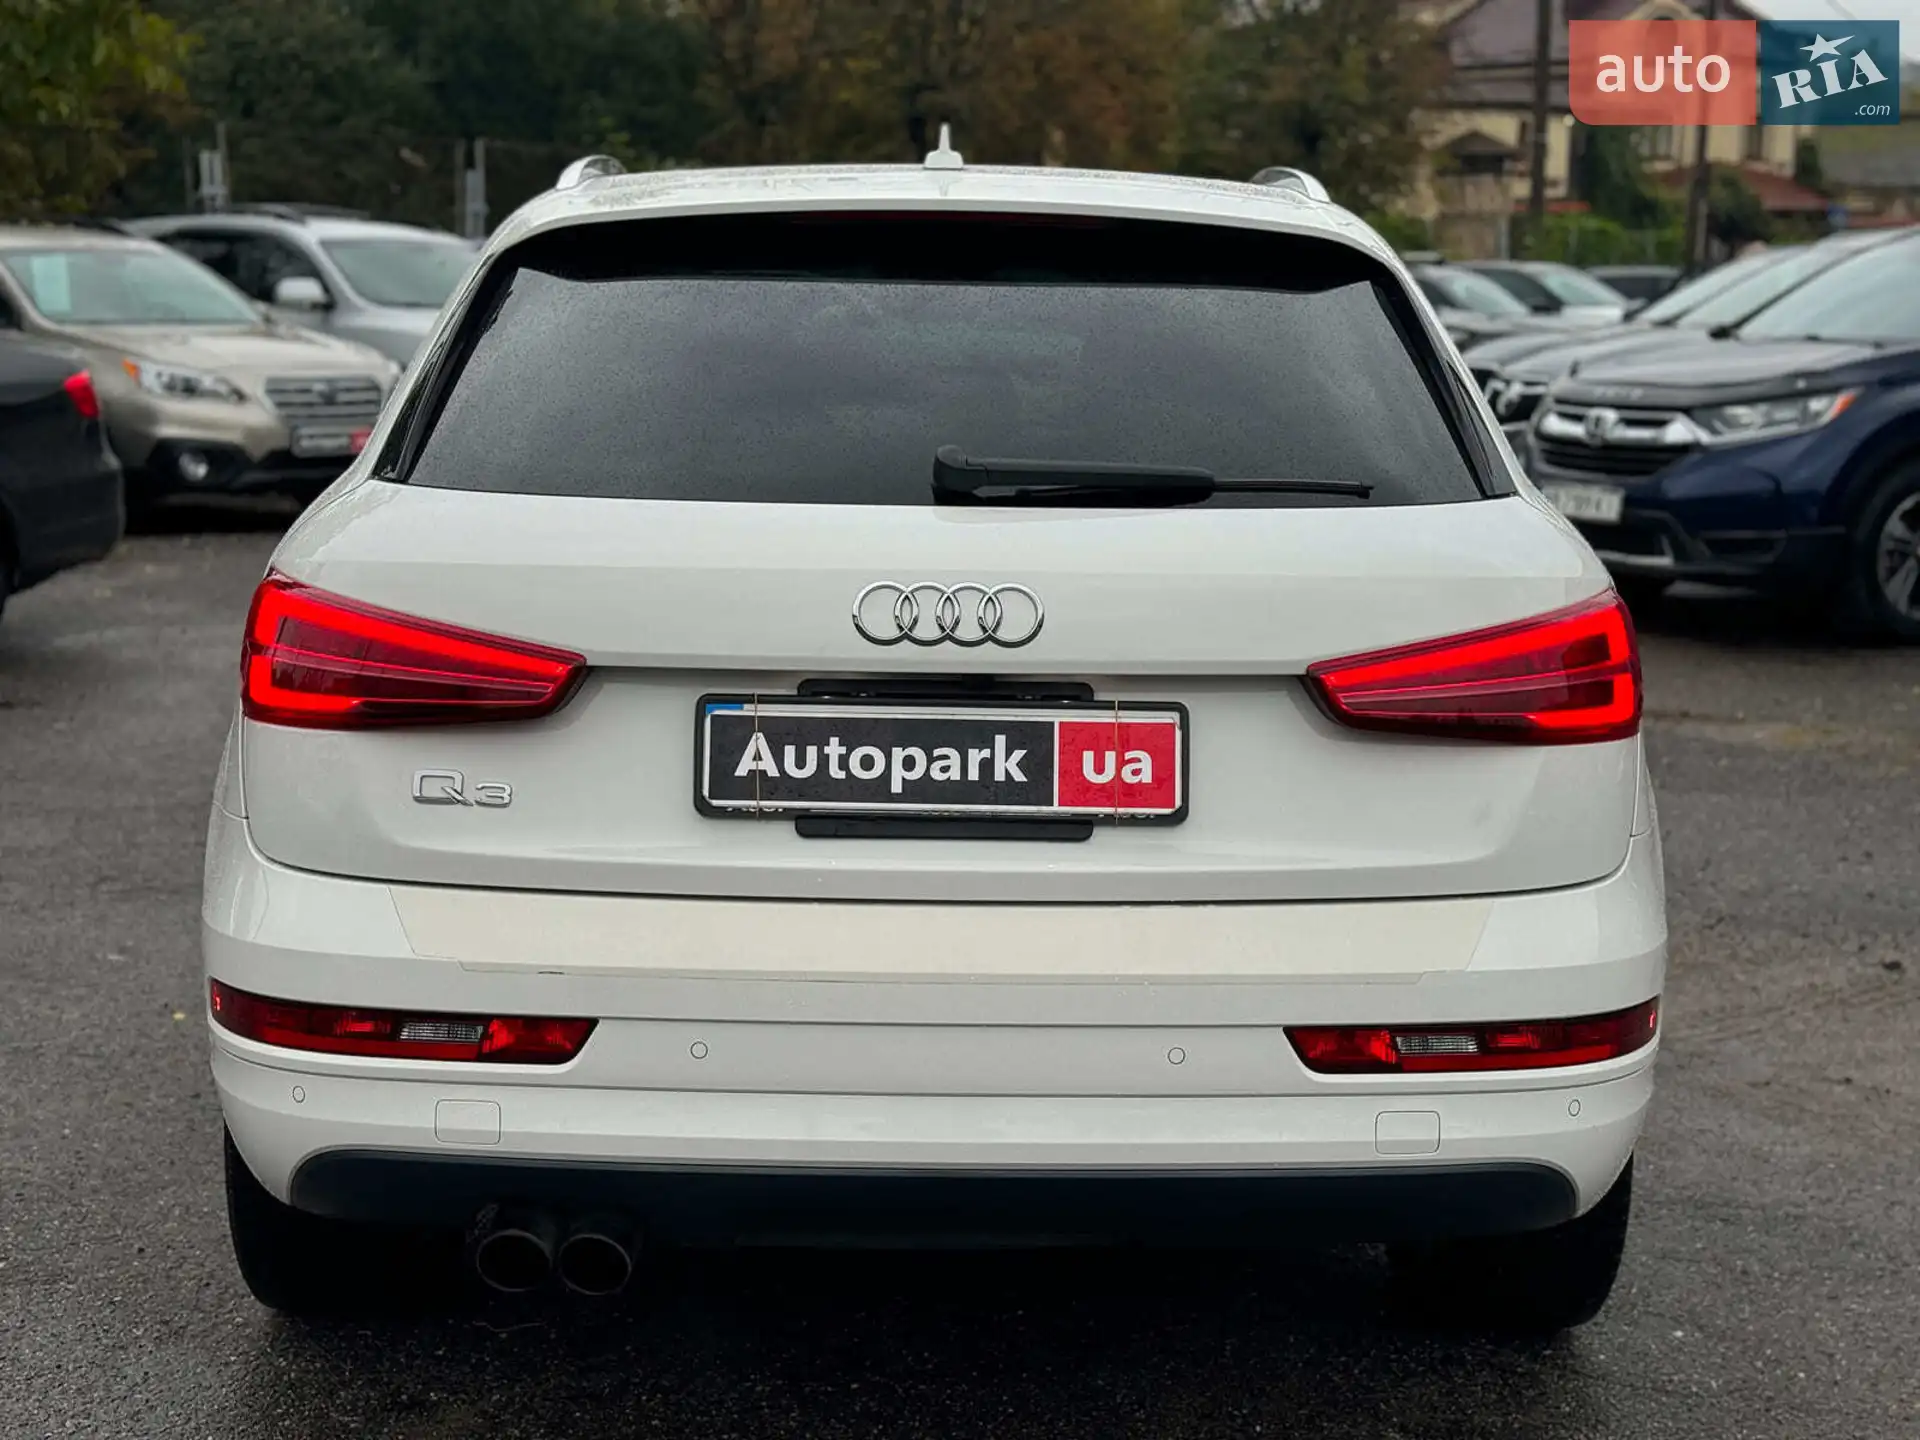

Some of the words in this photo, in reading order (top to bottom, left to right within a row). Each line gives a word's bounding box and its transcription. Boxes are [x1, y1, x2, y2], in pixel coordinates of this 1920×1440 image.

[412, 768, 513, 808] Q3
[734, 731, 1029, 794] Autopark
[1081, 747, 1153, 784] ua
